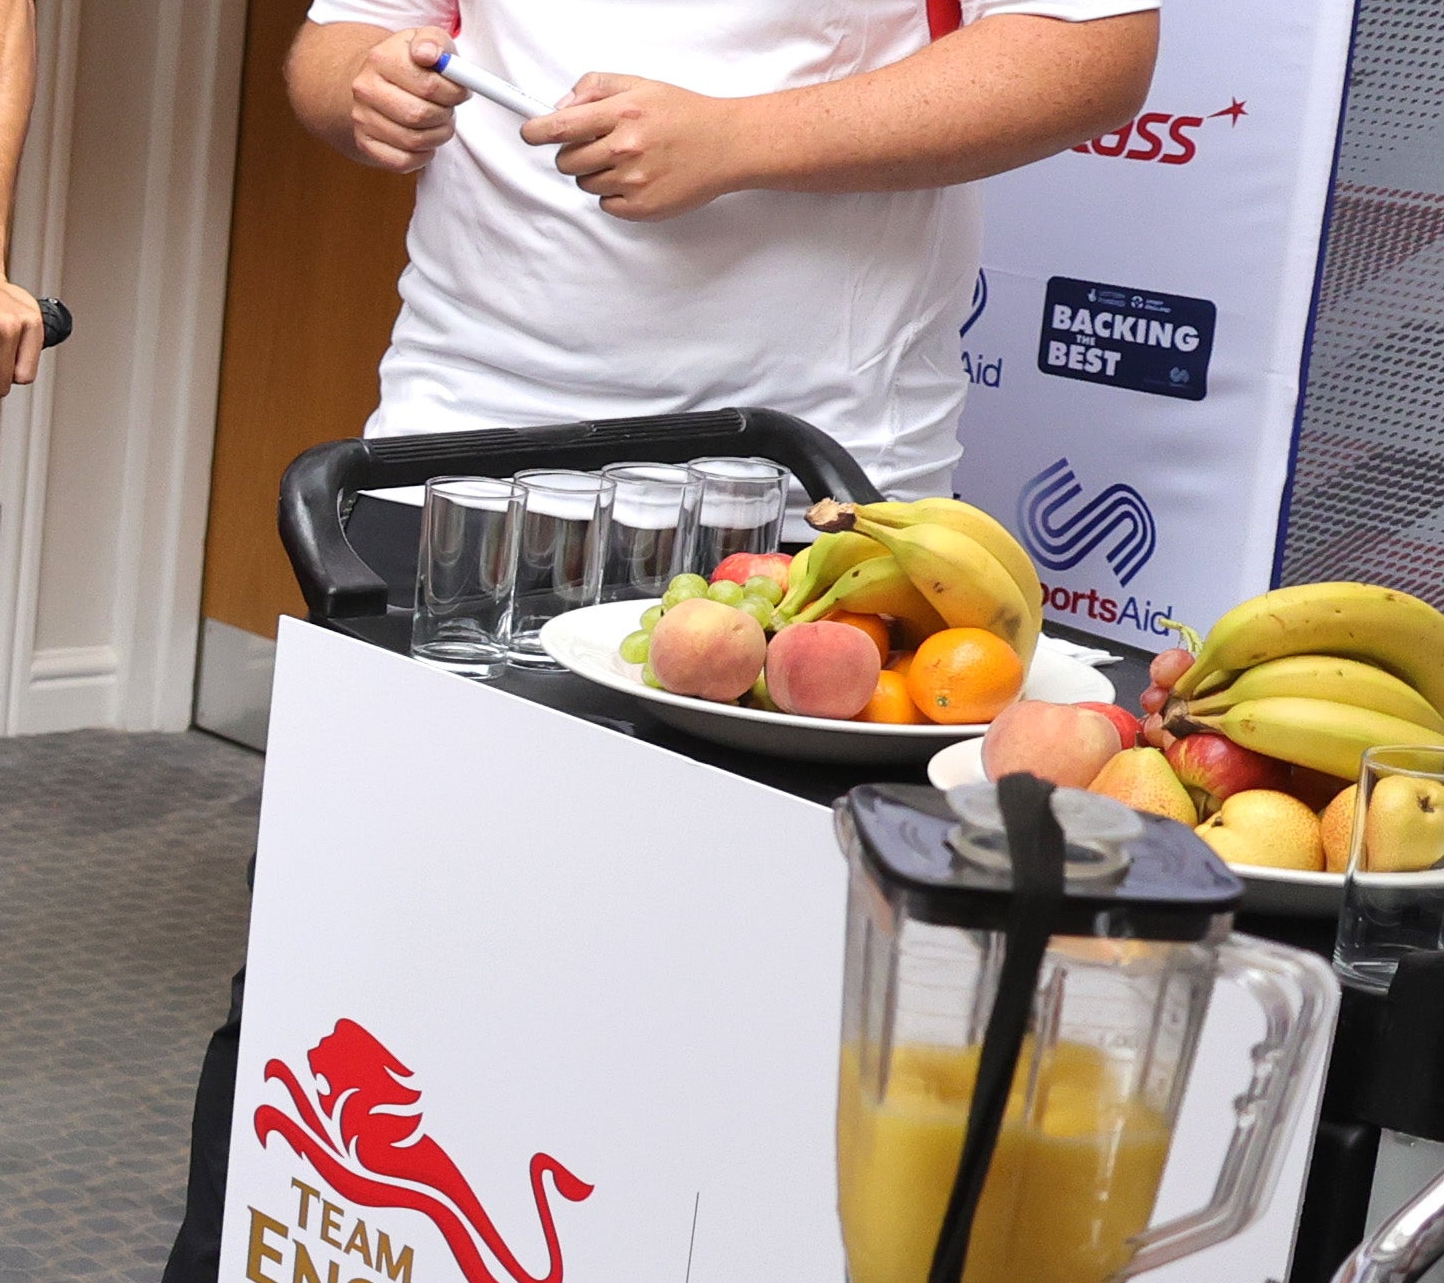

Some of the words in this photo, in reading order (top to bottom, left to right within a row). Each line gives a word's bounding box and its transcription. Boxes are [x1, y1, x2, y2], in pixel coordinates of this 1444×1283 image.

[1070, 112, 1205, 165] ass
[1051, 303, 1200, 353] BACKING
[1075, 334, 1097, 346] THE
[1046, 340, 1122, 377] BEST
